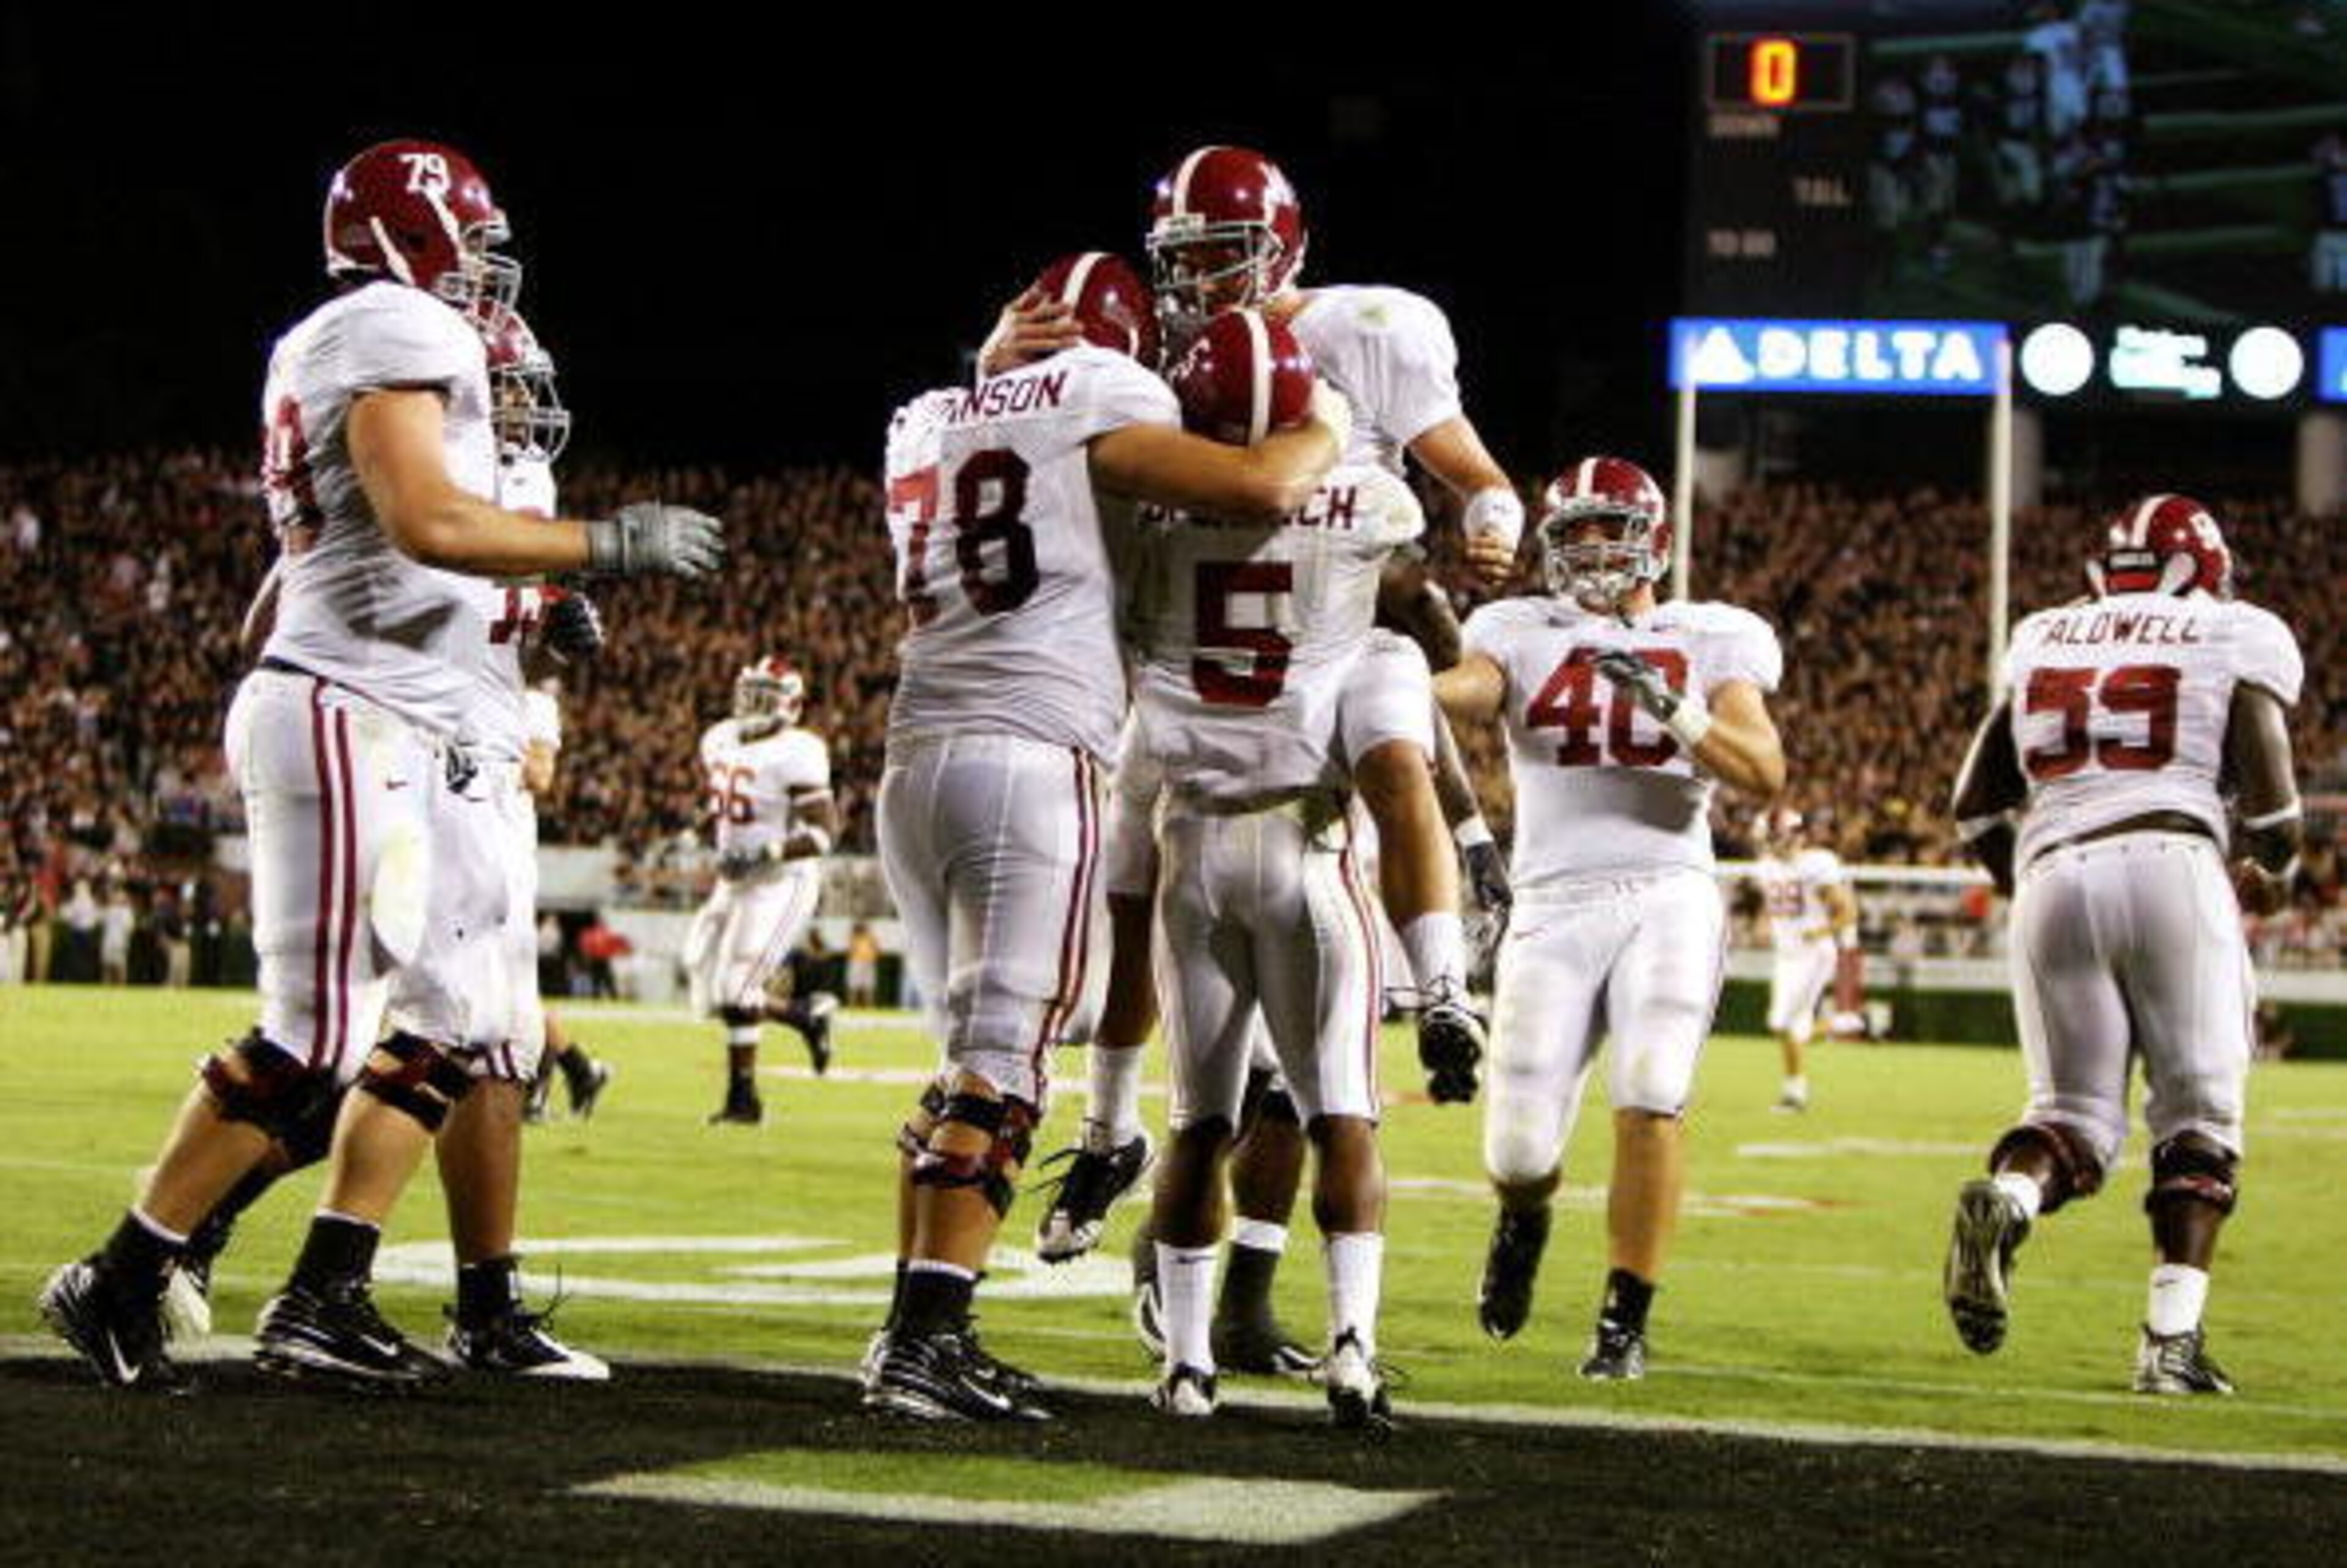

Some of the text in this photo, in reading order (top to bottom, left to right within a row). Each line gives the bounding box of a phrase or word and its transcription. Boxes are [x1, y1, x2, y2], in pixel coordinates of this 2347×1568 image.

[1750, 38, 1796, 104] 0
[399, 153, 452, 193] 79
[1756, 327, 1983, 381] DELTA
[917, 368, 1068, 426] NSON
[890, 449, 1040, 616] 78
[1191, 560, 1294, 707] 5
[2038, 611, 2201, 645] ALDWELL
[1526, 646, 1689, 768] 40
